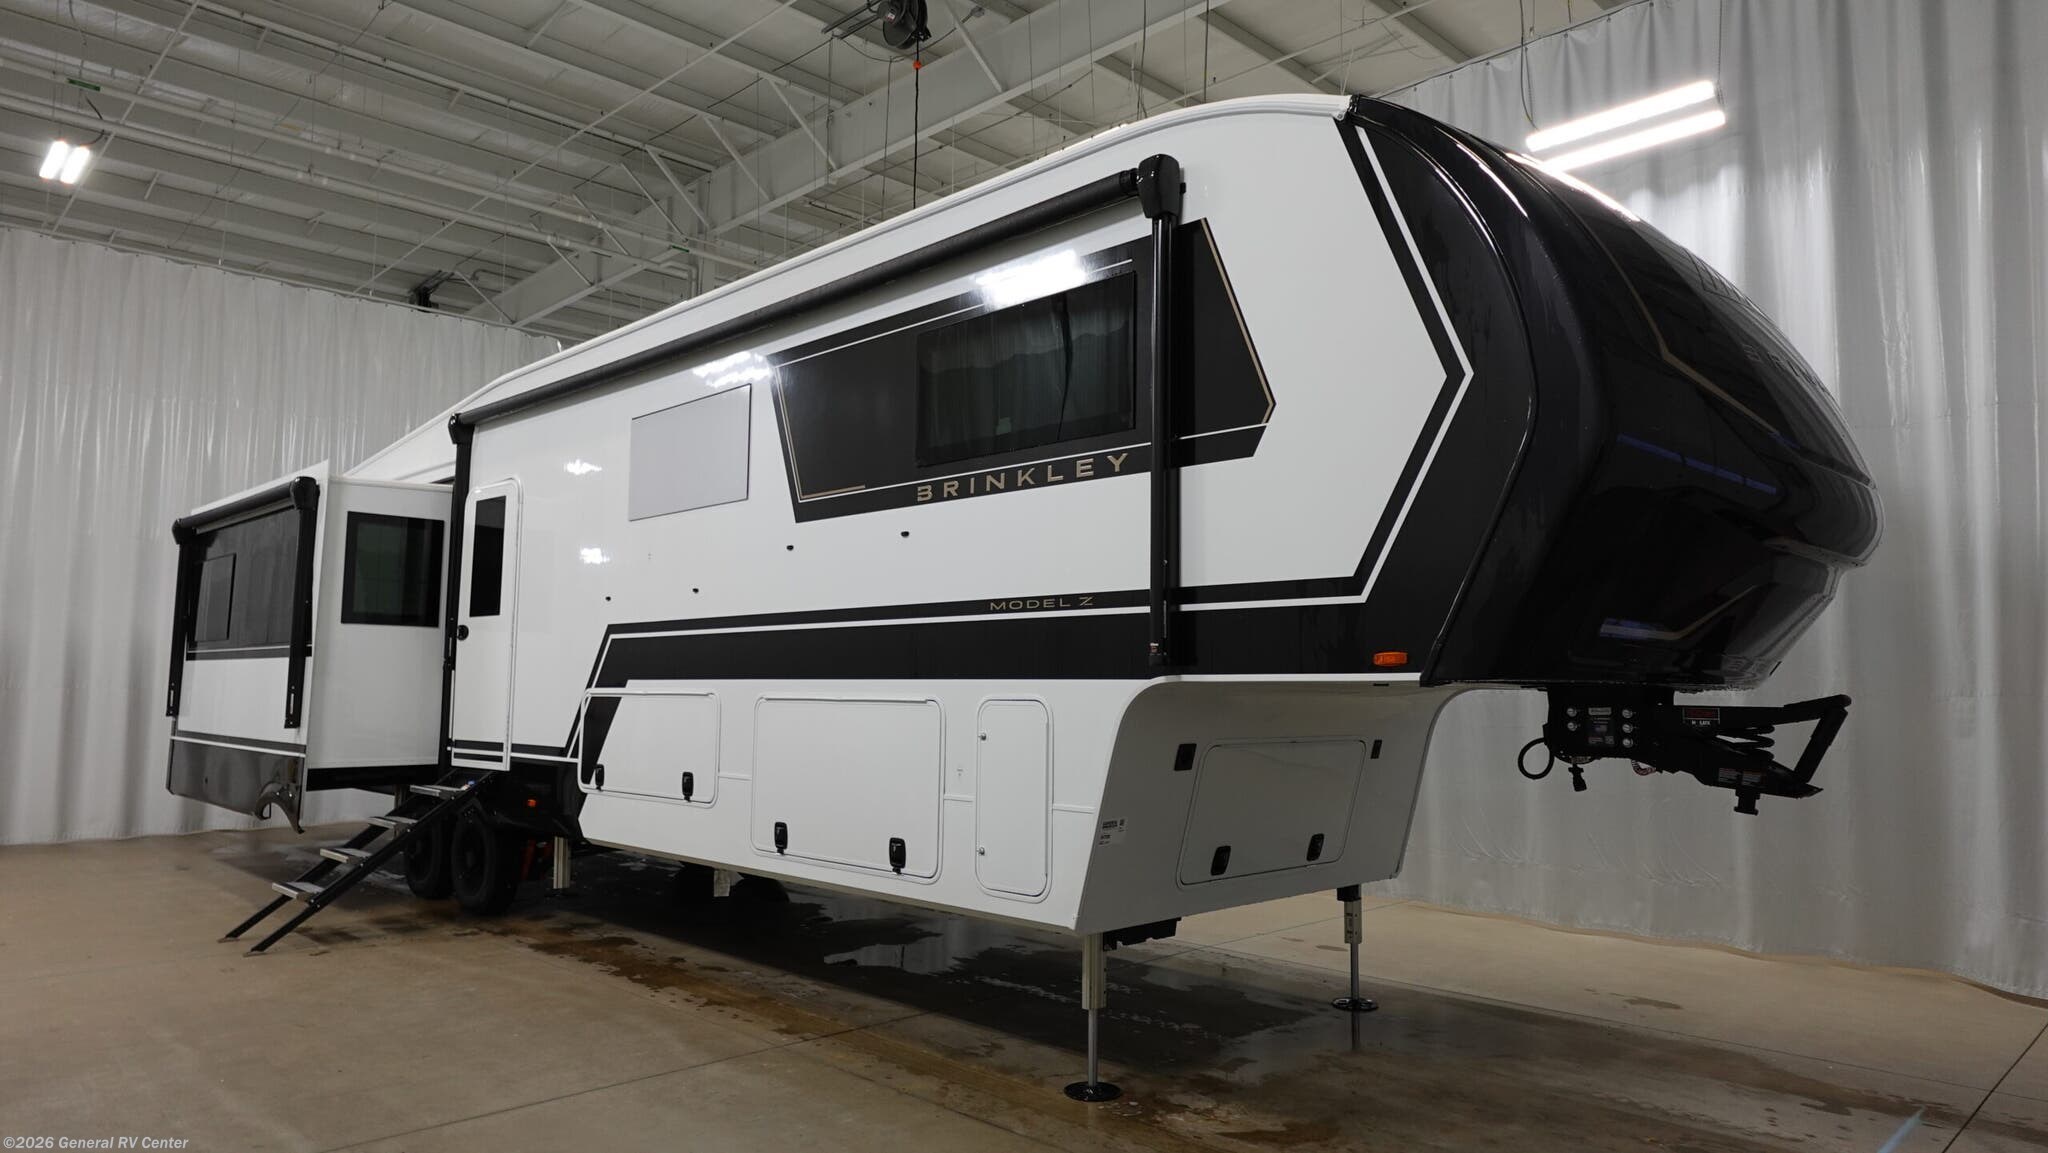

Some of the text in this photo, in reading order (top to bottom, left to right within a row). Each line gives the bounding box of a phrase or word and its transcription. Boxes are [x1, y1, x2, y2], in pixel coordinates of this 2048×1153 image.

[916, 452, 1129, 502] BRINKLEY
[989, 596, 1095, 612] MODEL Z
